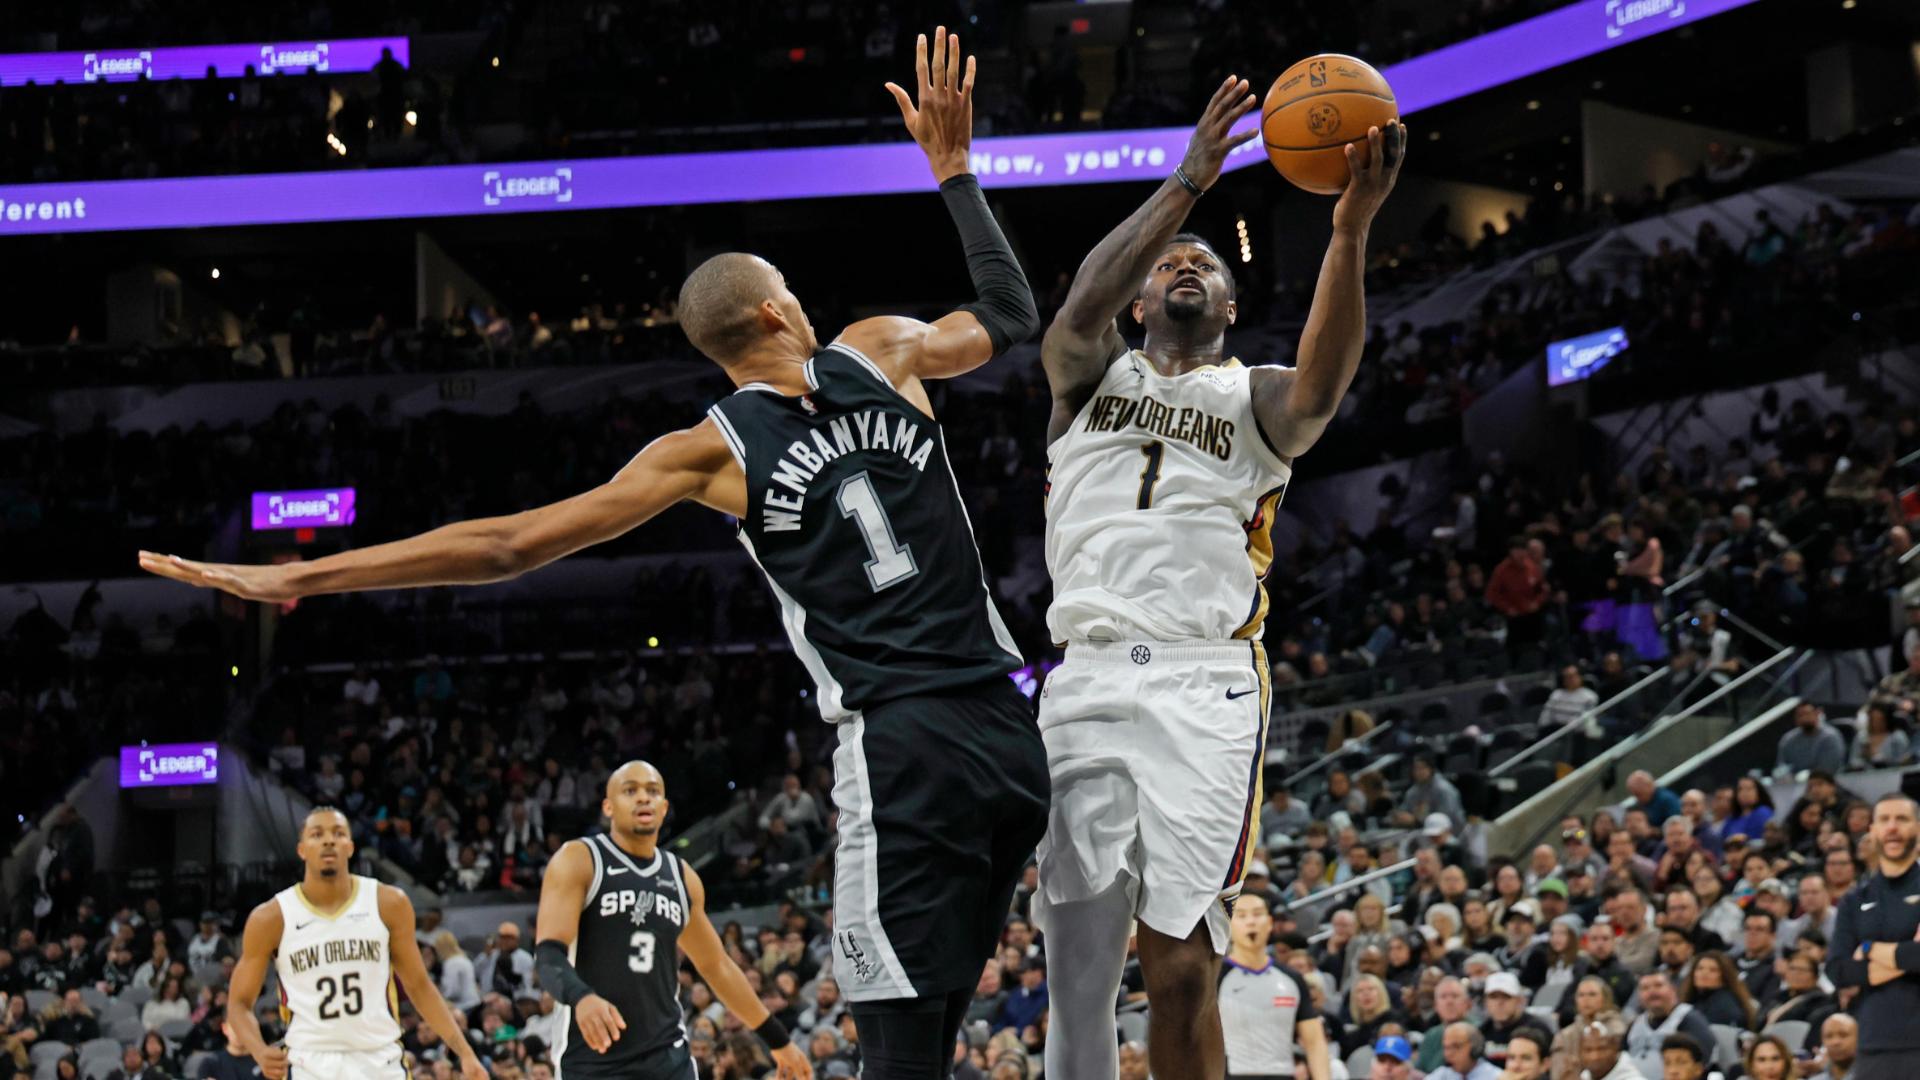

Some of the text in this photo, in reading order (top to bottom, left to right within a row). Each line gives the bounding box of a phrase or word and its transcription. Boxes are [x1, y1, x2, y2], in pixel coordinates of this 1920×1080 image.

[1064, 145, 1166, 176] you're
[495, 176, 560, 197] LEDGER
[1083, 395, 1235, 461] NEW ORLEANS
[763, 410, 935, 533] WEMBANYAMA
[1136, 439, 1165, 510] 1
[836, 470, 919, 593] 1
[150, 756, 206, 775] LEDGER
[289, 938, 382, 974] NEW ORLEANS
[628, 931, 656, 973] 3
[316, 971, 363, 1020] 25
